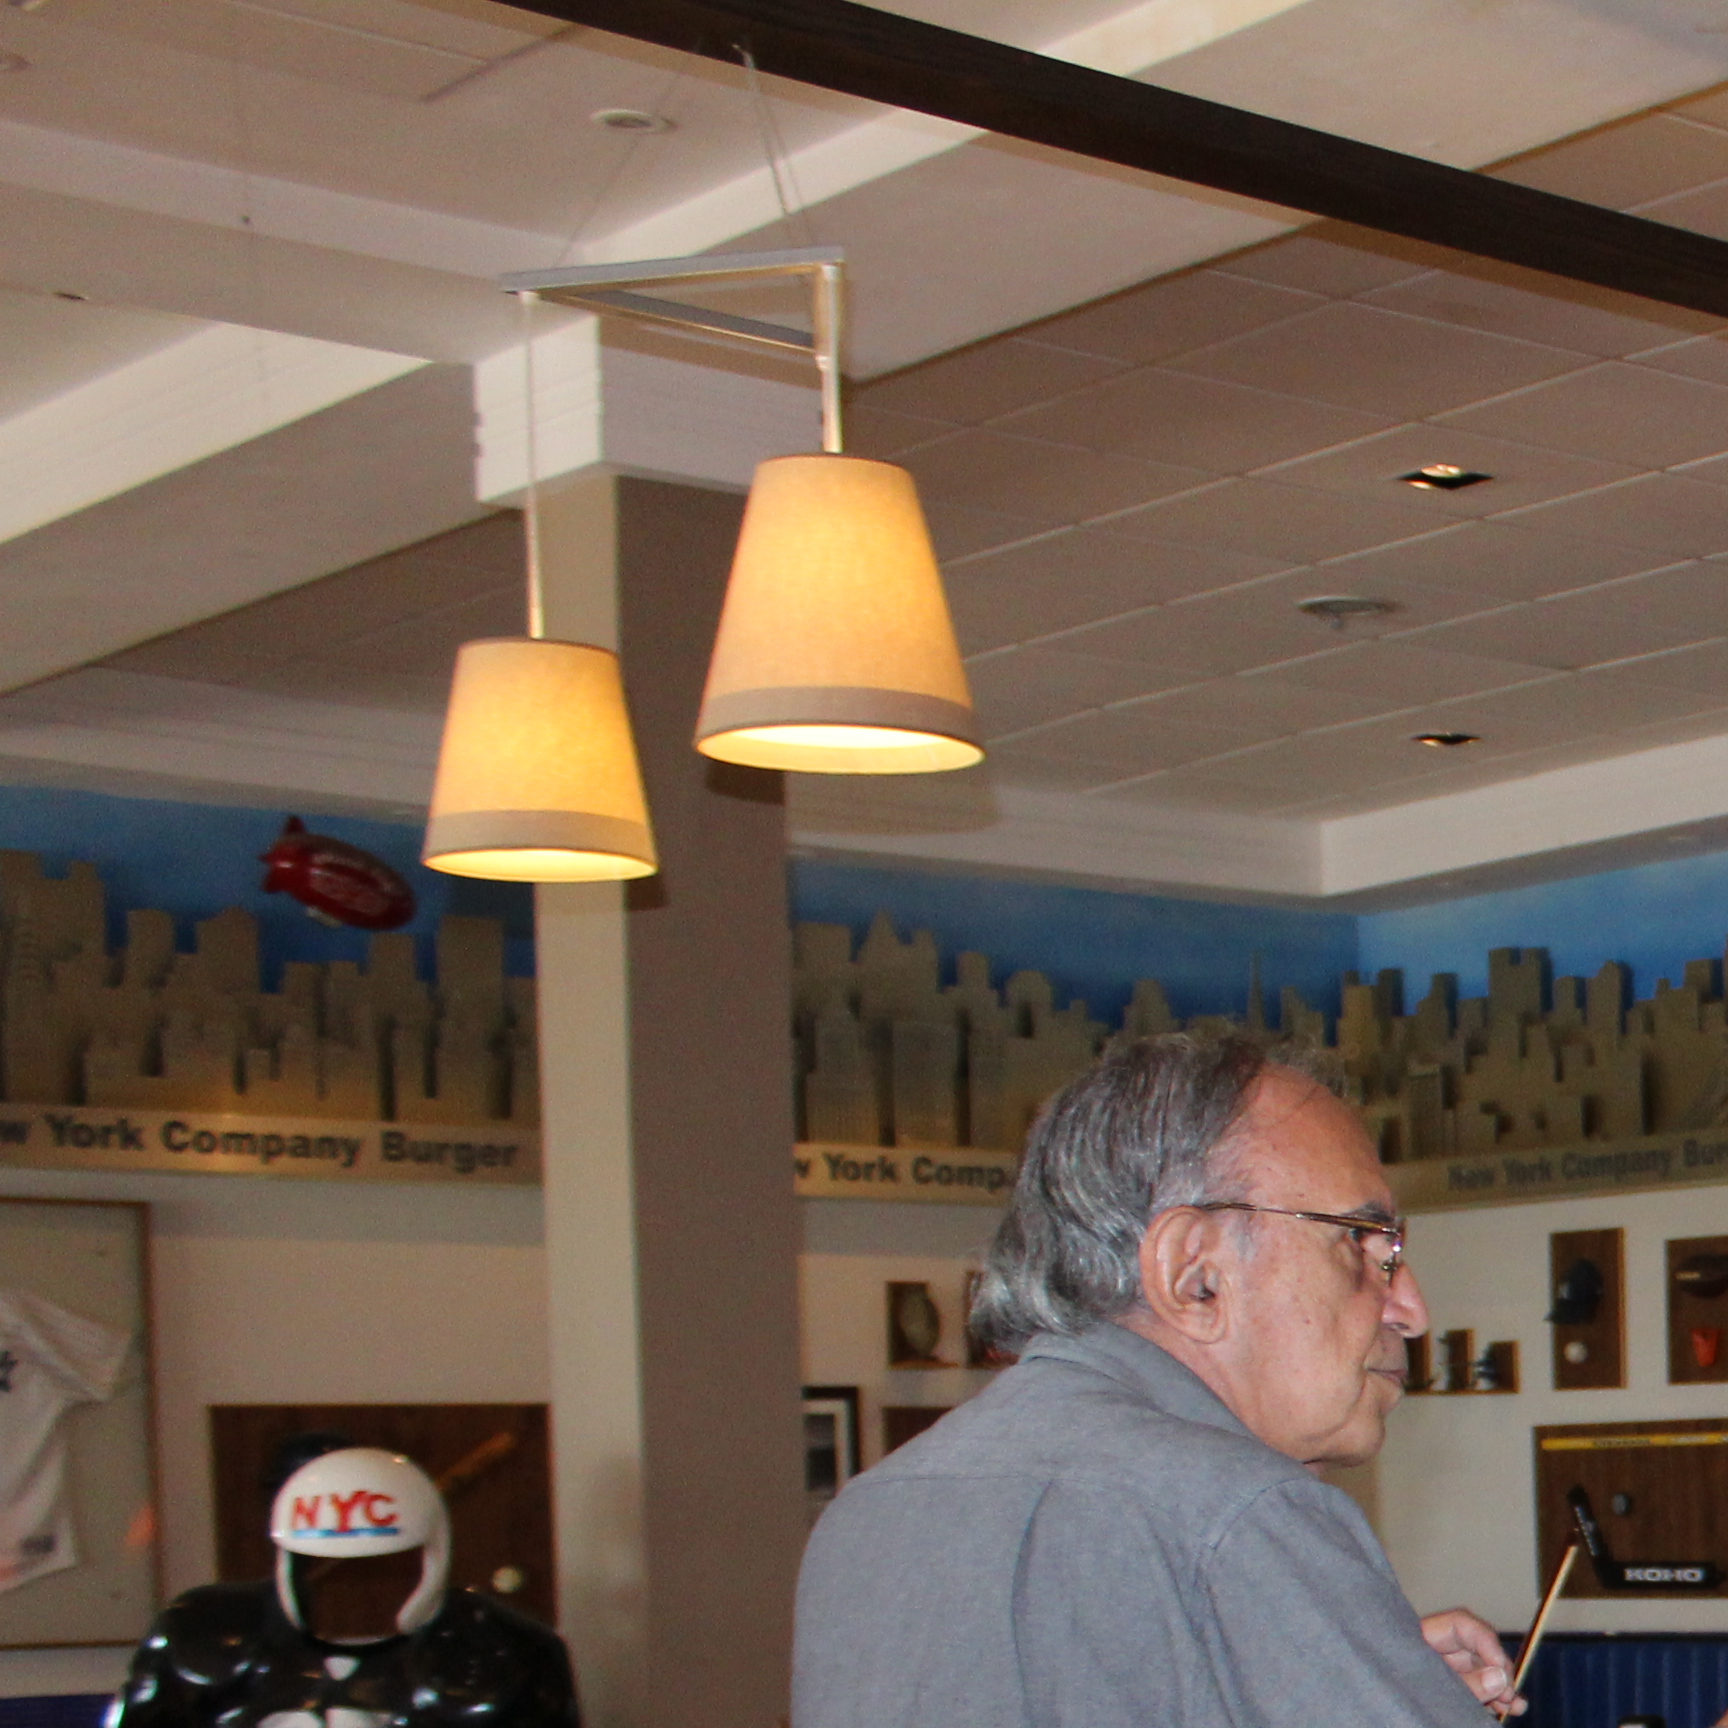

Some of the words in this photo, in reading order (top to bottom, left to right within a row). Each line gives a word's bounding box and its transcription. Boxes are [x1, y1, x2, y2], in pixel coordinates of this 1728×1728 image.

[44, 1113, 144, 1151] York
[159, 1119, 364, 1168] Company
[380, 1130, 518, 1174] Burger
[823, 1152, 897, 1183] York
[911, 1155, 1007, 1195] Comp
[1447, 1165, 1495, 1189] New
[1504, 1155, 1551, 1185] York
[1561, 1150, 1671, 1182] Company
[290, 1490, 399, 1533] NYC
